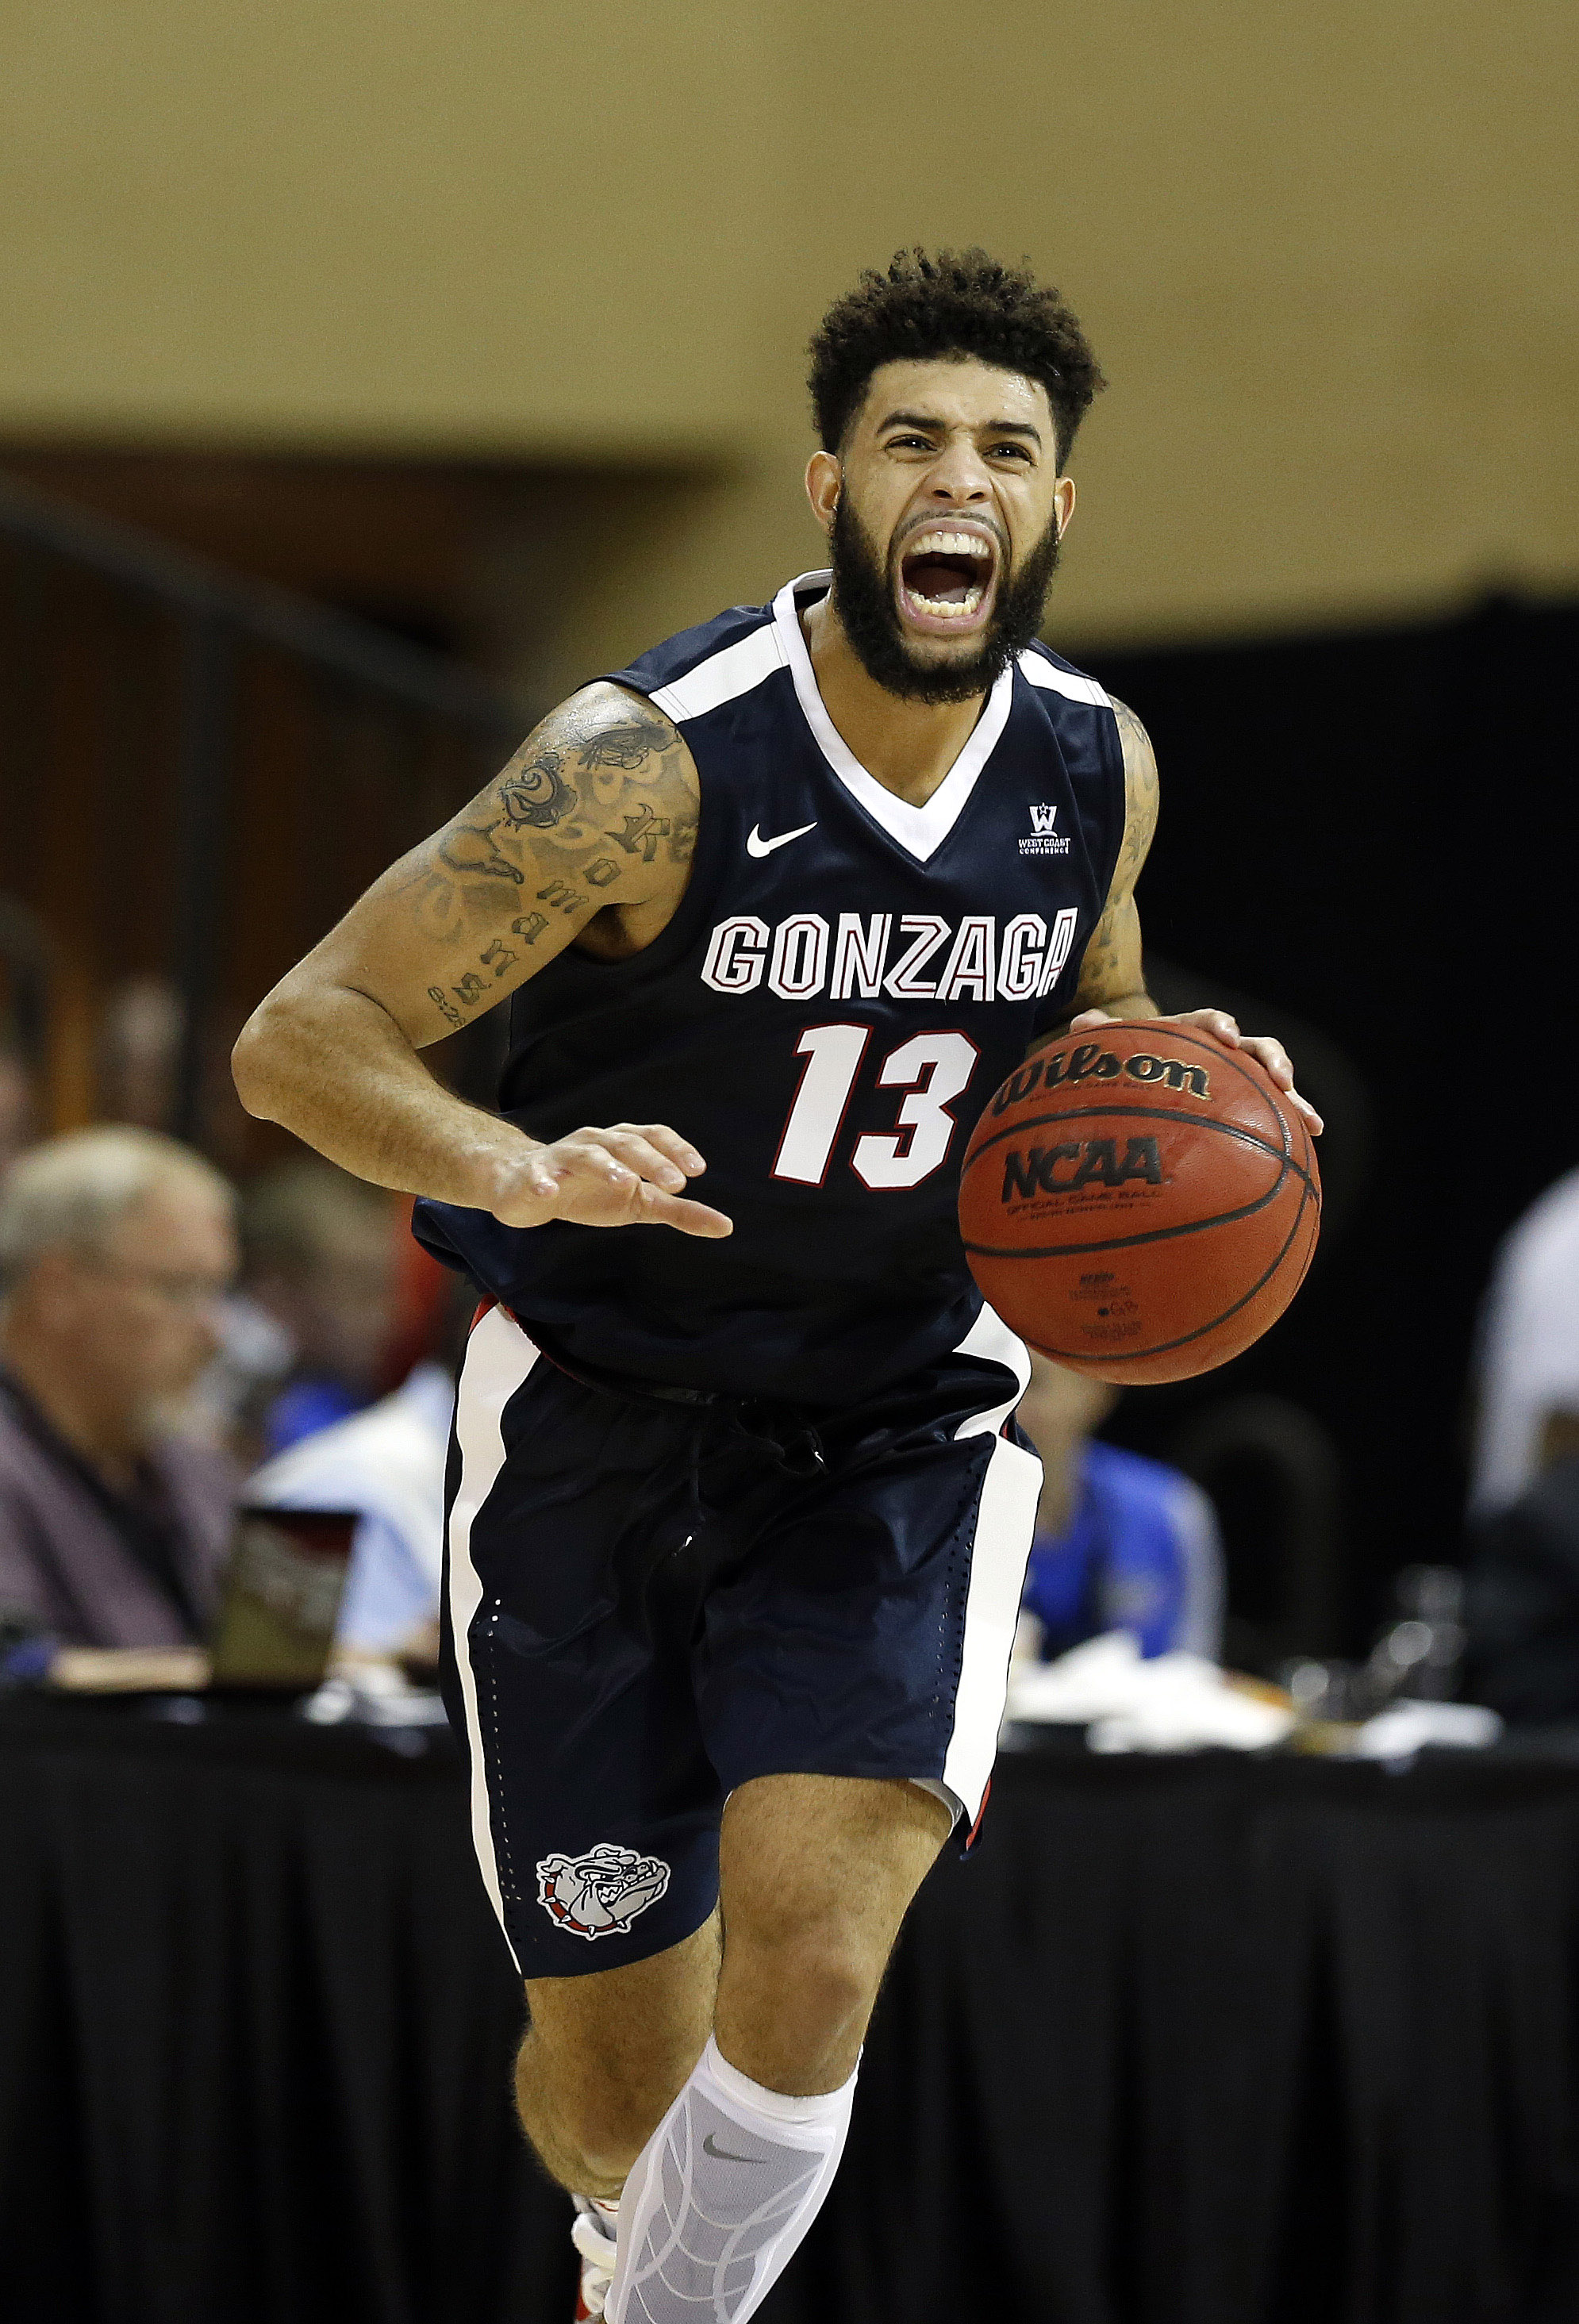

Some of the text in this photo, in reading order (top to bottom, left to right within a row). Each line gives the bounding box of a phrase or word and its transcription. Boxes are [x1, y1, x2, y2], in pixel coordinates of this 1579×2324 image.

[1018, 837, 1071, 848] WEST COAST
[701, 907, 1078, 1001] GONZAGA
[769, 1021, 982, 1191] 13
[991, 1043, 1214, 1117] Wilson
[1001, 1136, 1162, 1204] NCAA
